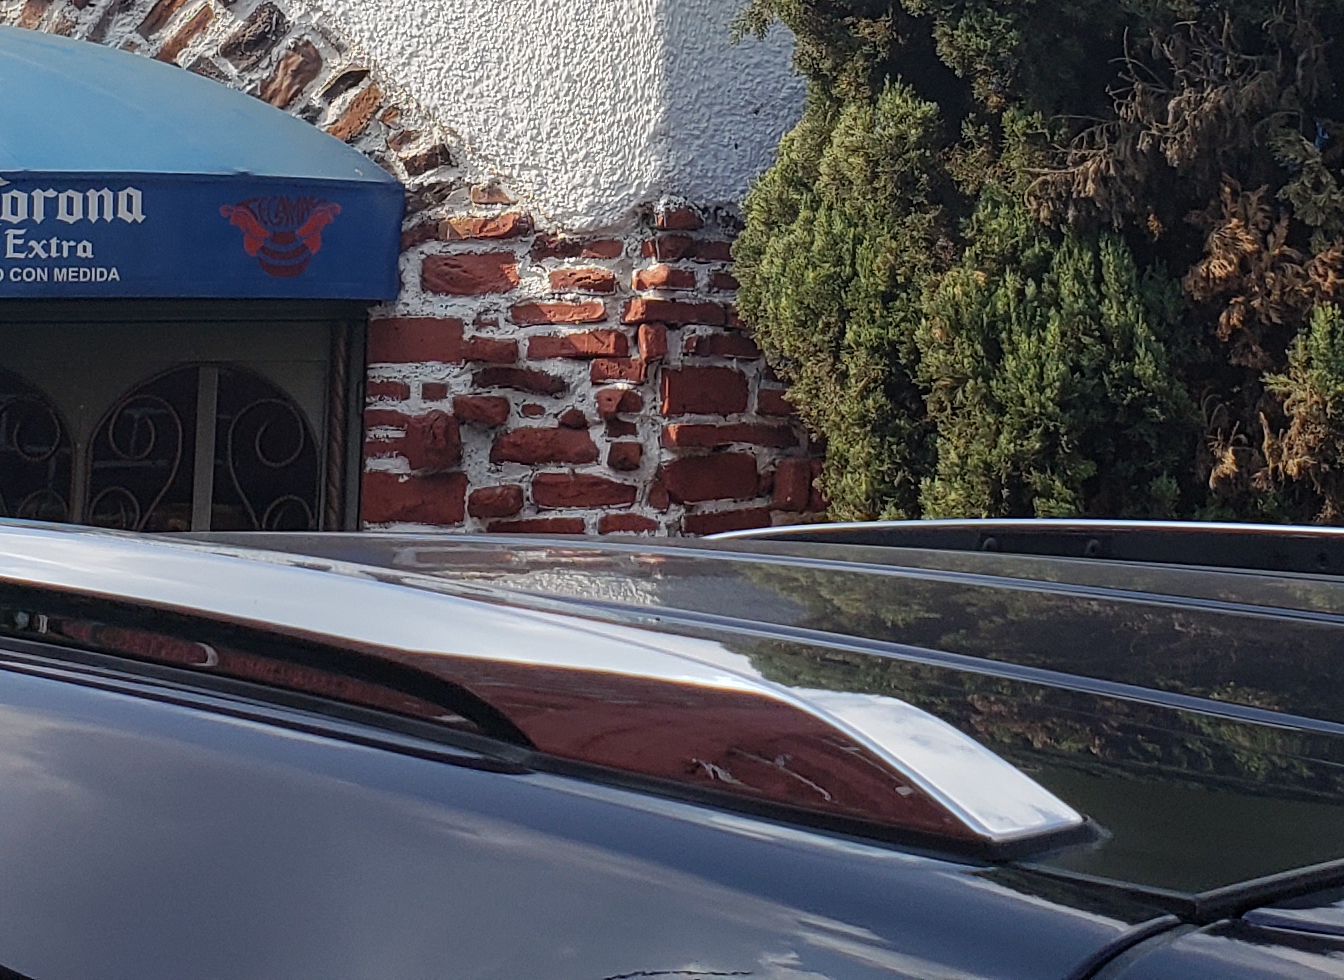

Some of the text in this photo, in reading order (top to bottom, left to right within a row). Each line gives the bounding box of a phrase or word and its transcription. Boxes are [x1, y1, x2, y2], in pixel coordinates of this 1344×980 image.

[4, 228, 94, 259] Extra
[9, 267, 48, 283] CON
[53, 266, 121, 282] MEDIDA
